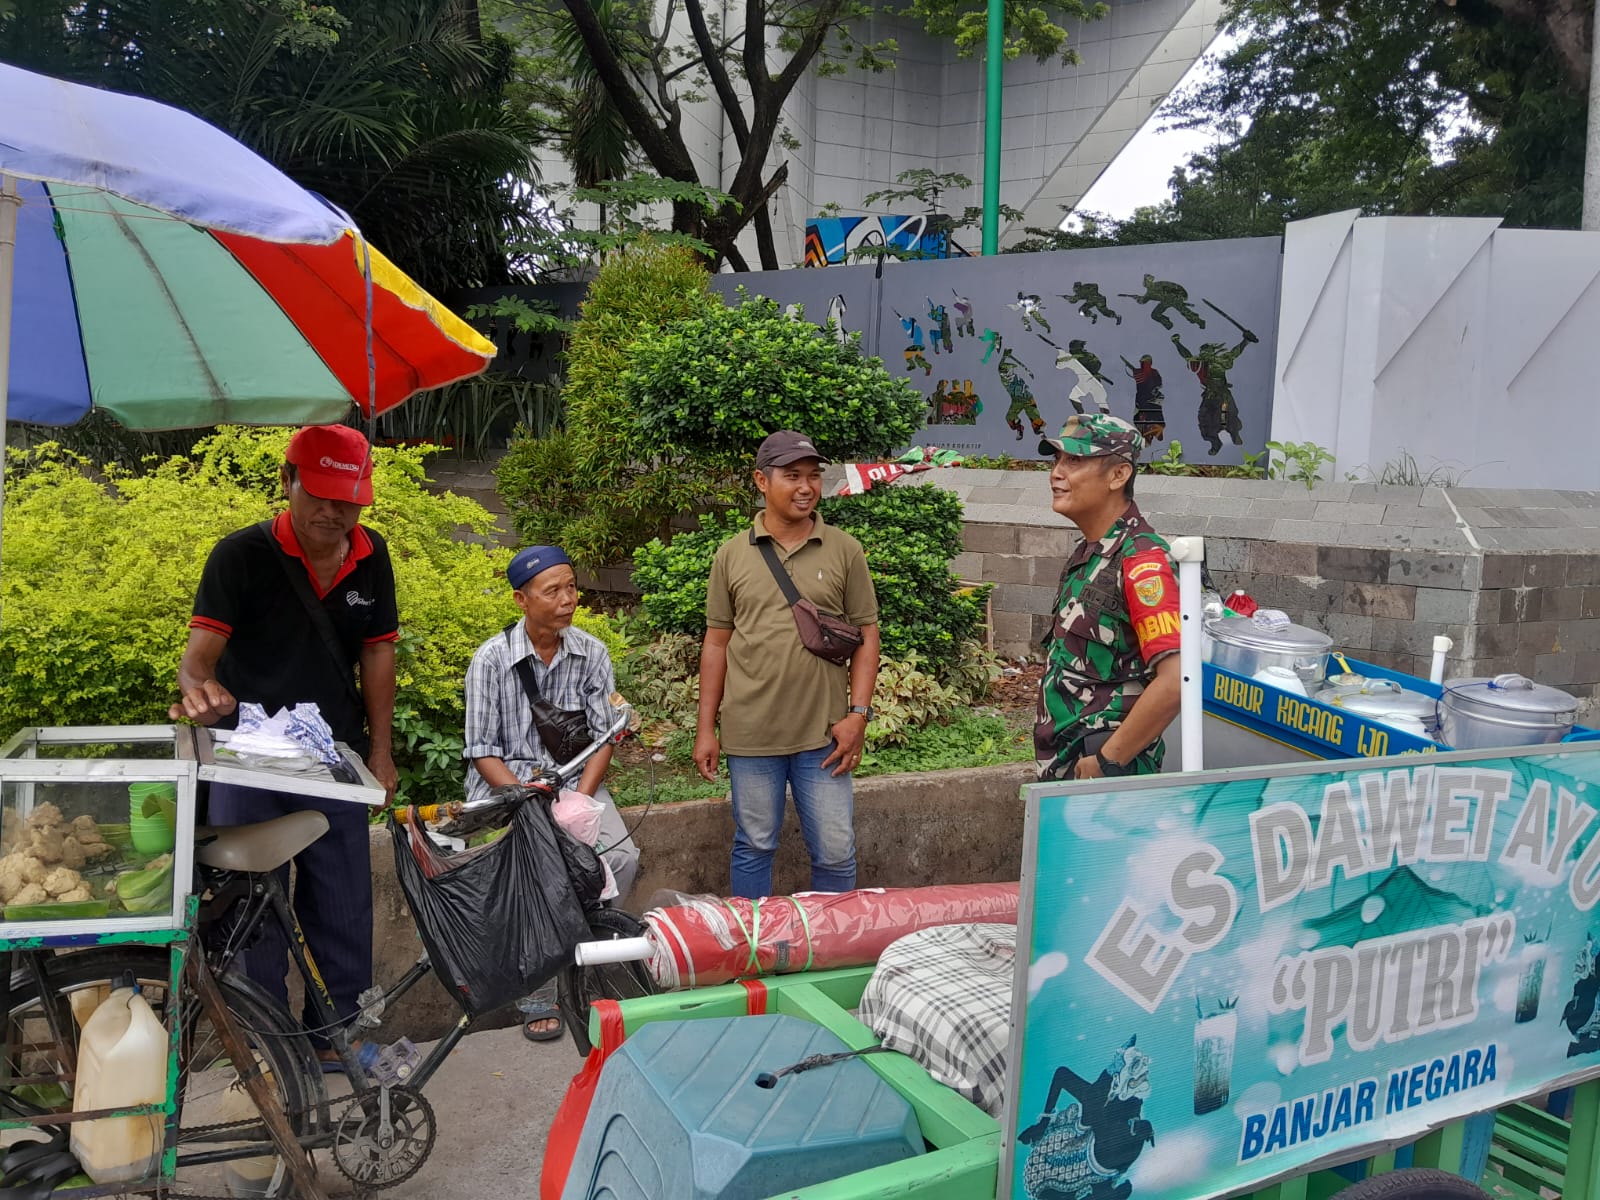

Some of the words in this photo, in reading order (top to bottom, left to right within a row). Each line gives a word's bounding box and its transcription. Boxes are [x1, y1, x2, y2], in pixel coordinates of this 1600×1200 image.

[1214, 673, 1264, 716] BUBUR
[1276, 694, 1344, 746] KACANG
[1087, 848, 1236, 1008] ES
[1251, 767, 1511, 909] DAWET
[1240, 1080, 1377, 1161] BANJAR
[1385, 1043, 1497, 1115] NEGARA
